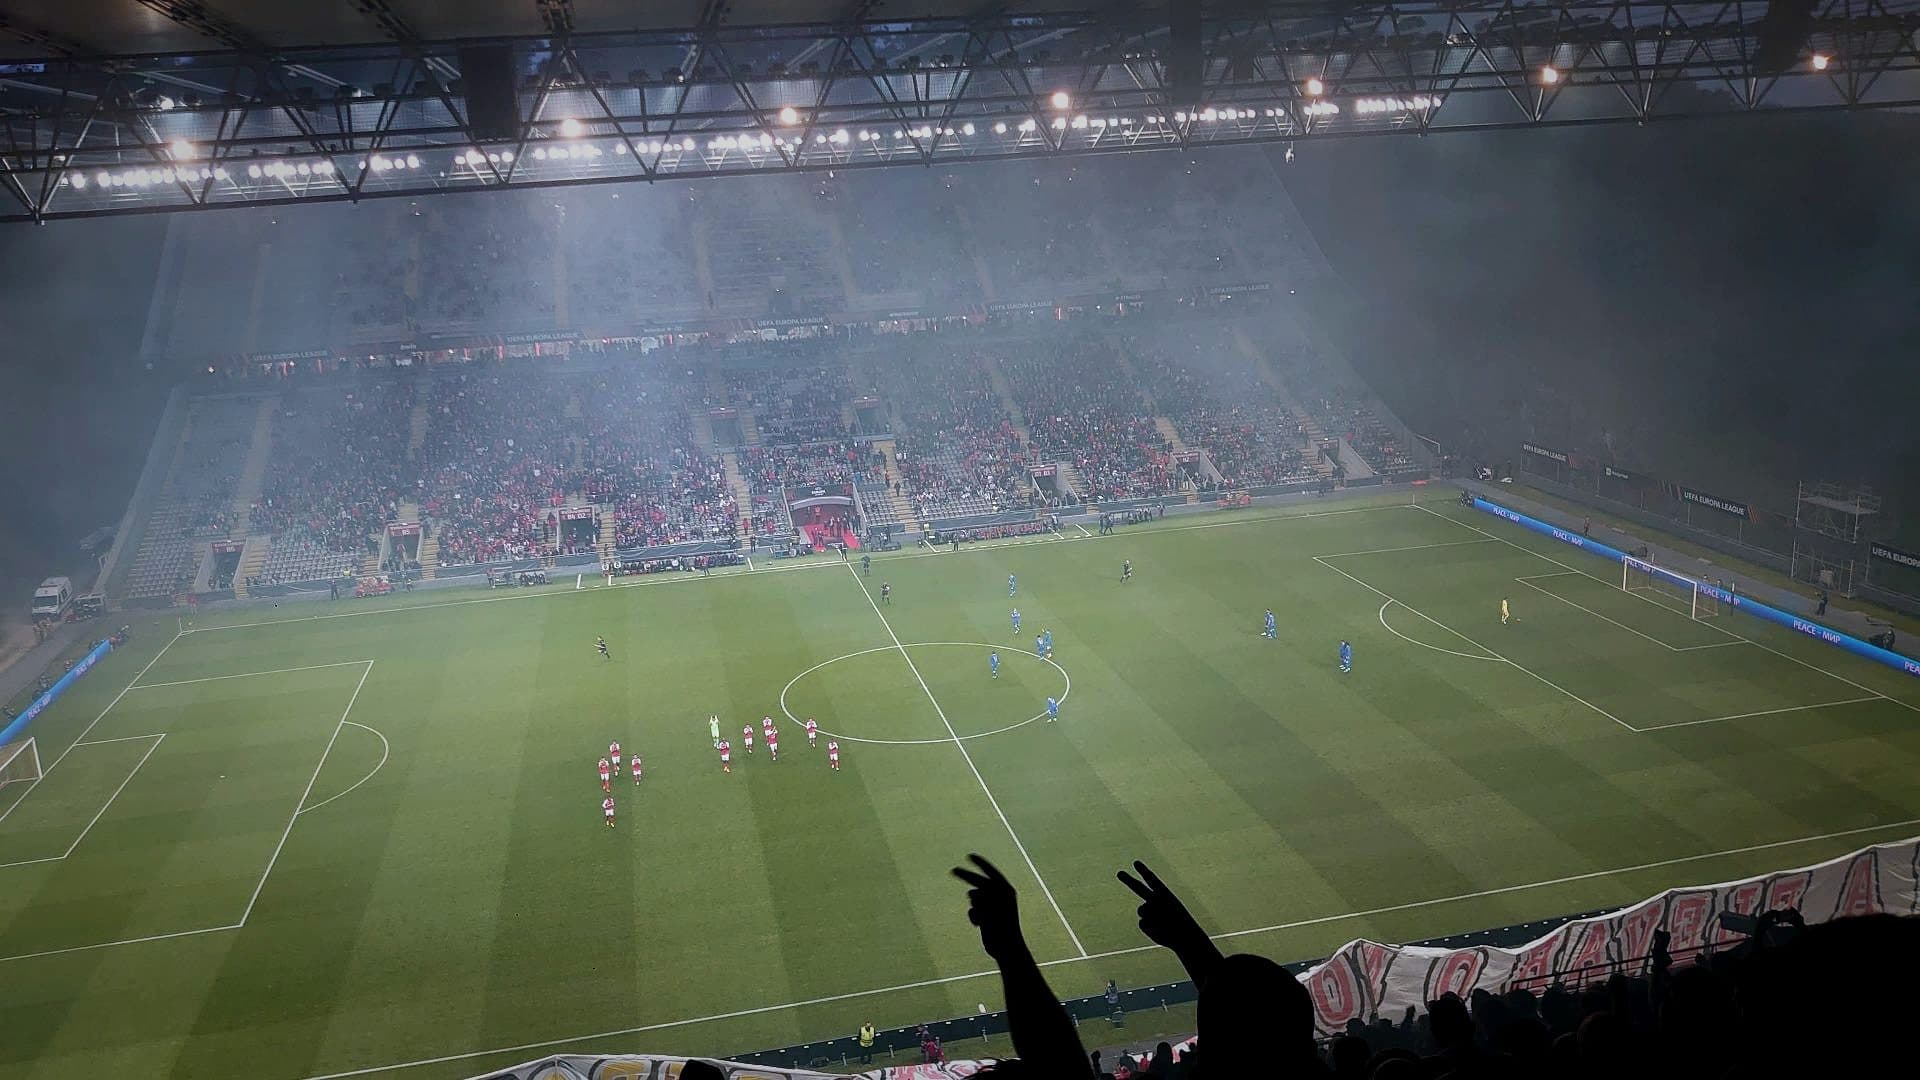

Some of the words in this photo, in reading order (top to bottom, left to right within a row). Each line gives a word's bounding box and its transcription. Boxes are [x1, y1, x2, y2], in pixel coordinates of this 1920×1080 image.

[1684, 491, 1699, 502] UEFA
[1700, 495, 1721, 508] EUROPA
[1721, 501, 1745, 515] LEAGUE
[1552, 529, 1568, 541] PEACE
[1872, 546, 1892, 560] UEFA
[1700, 585, 1720, 599] PEACE
[1793, 620, 1816, 636] PEACE
